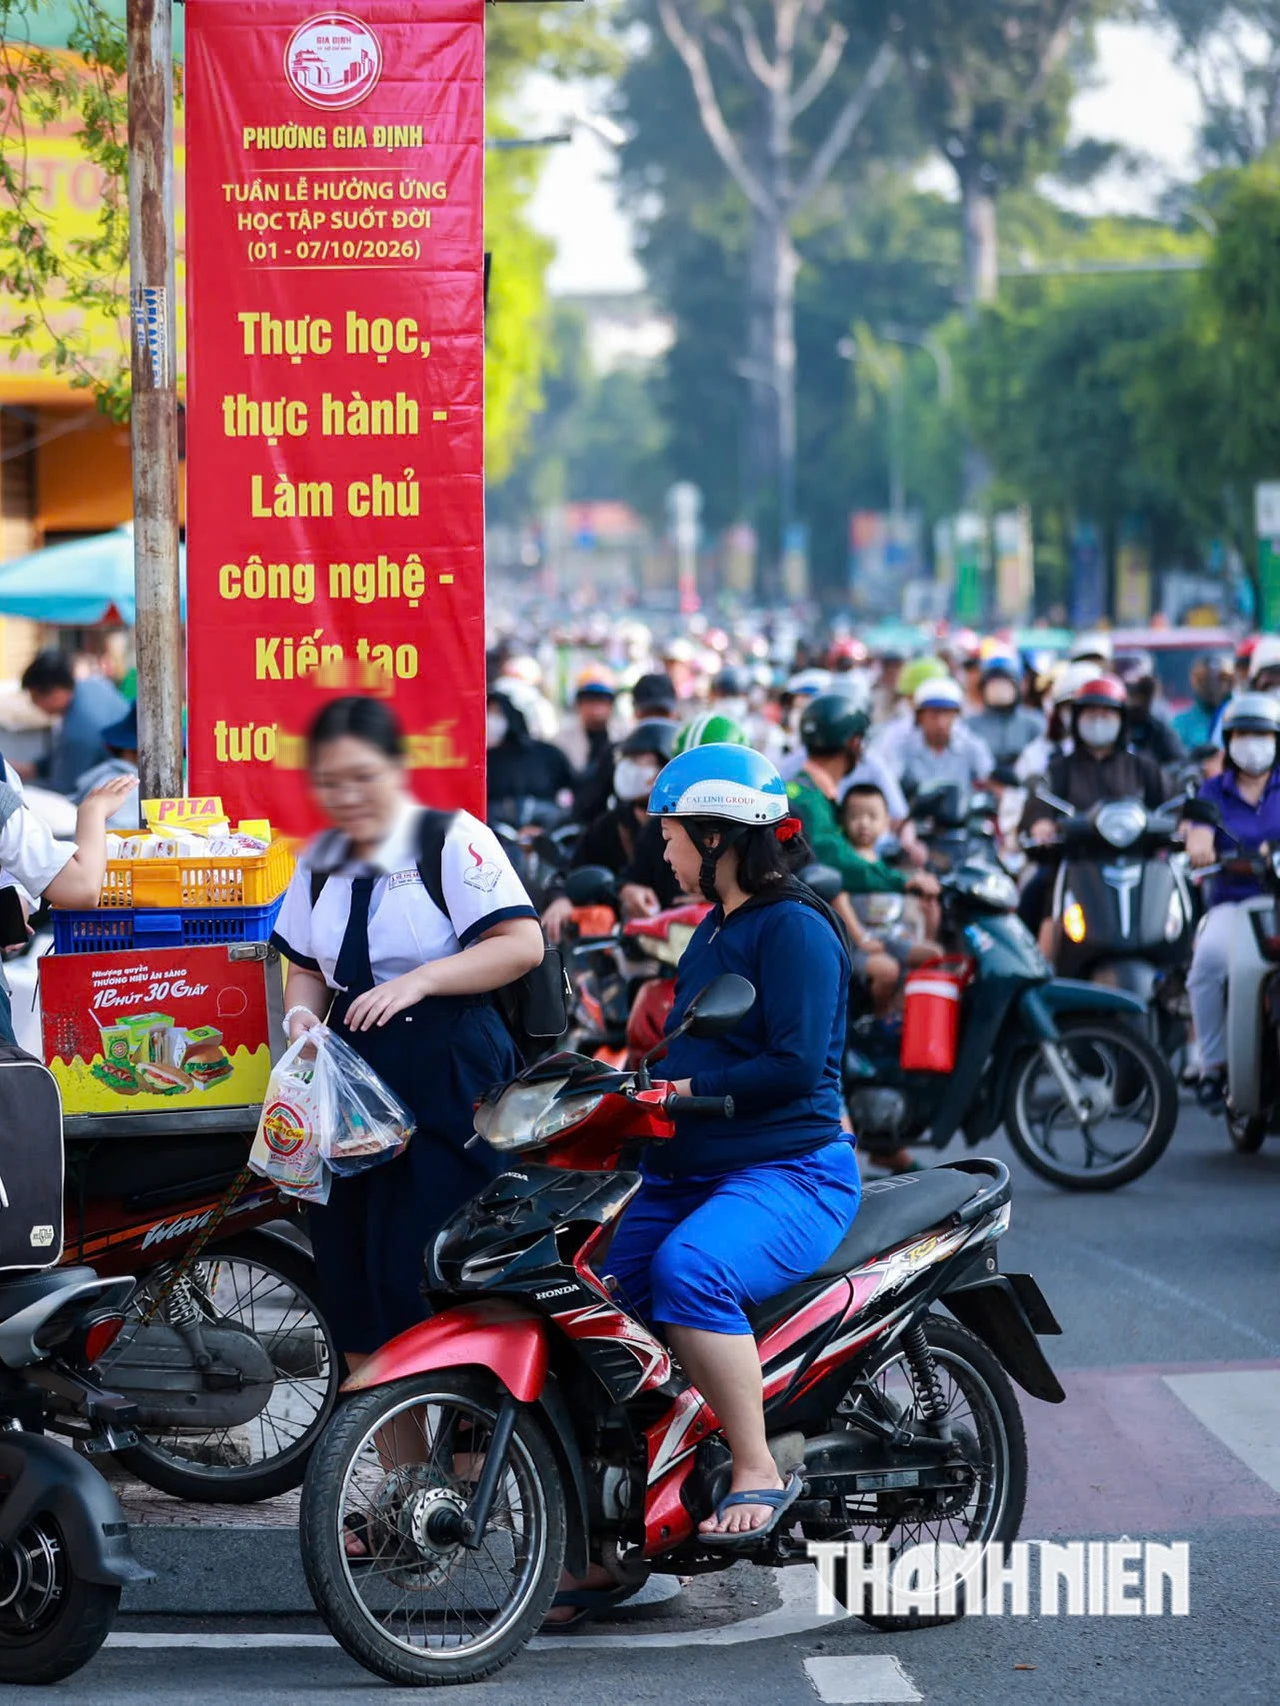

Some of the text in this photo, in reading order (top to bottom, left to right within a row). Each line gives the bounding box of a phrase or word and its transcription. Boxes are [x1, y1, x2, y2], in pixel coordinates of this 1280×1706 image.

[243, 121, 423, 152] PHƯỜNG GIA ĐỊNH
[222, 177, 447, 202] TUẦN LỄ HƯỞNG ỨNG
[238, 206, 431, 235] HỌC TẬP SUỐT ĐỜI
[248, 241, 277, 262] (01
[297, 239, 421, 261] 07/10/2026)
[238, 310, 431, 364] Thực học,
[222, 391, 448, 446] thực hành -
[251, 467, 420, 518] Làm chủ
[219, 553, 454, 608] công nghệ -
[158, 799, 216, 821] PITA
[725, 796, 756, 805] GROUP
[92, 964, 148, 979] Nhượng quyền
[93, 977, 128, 987] THƯƠNG
[129, 973, 148, 984] HIỆU
[141, 1209, 215, 1251] Wav
[535, 1284, 580, 1300] HONDA
